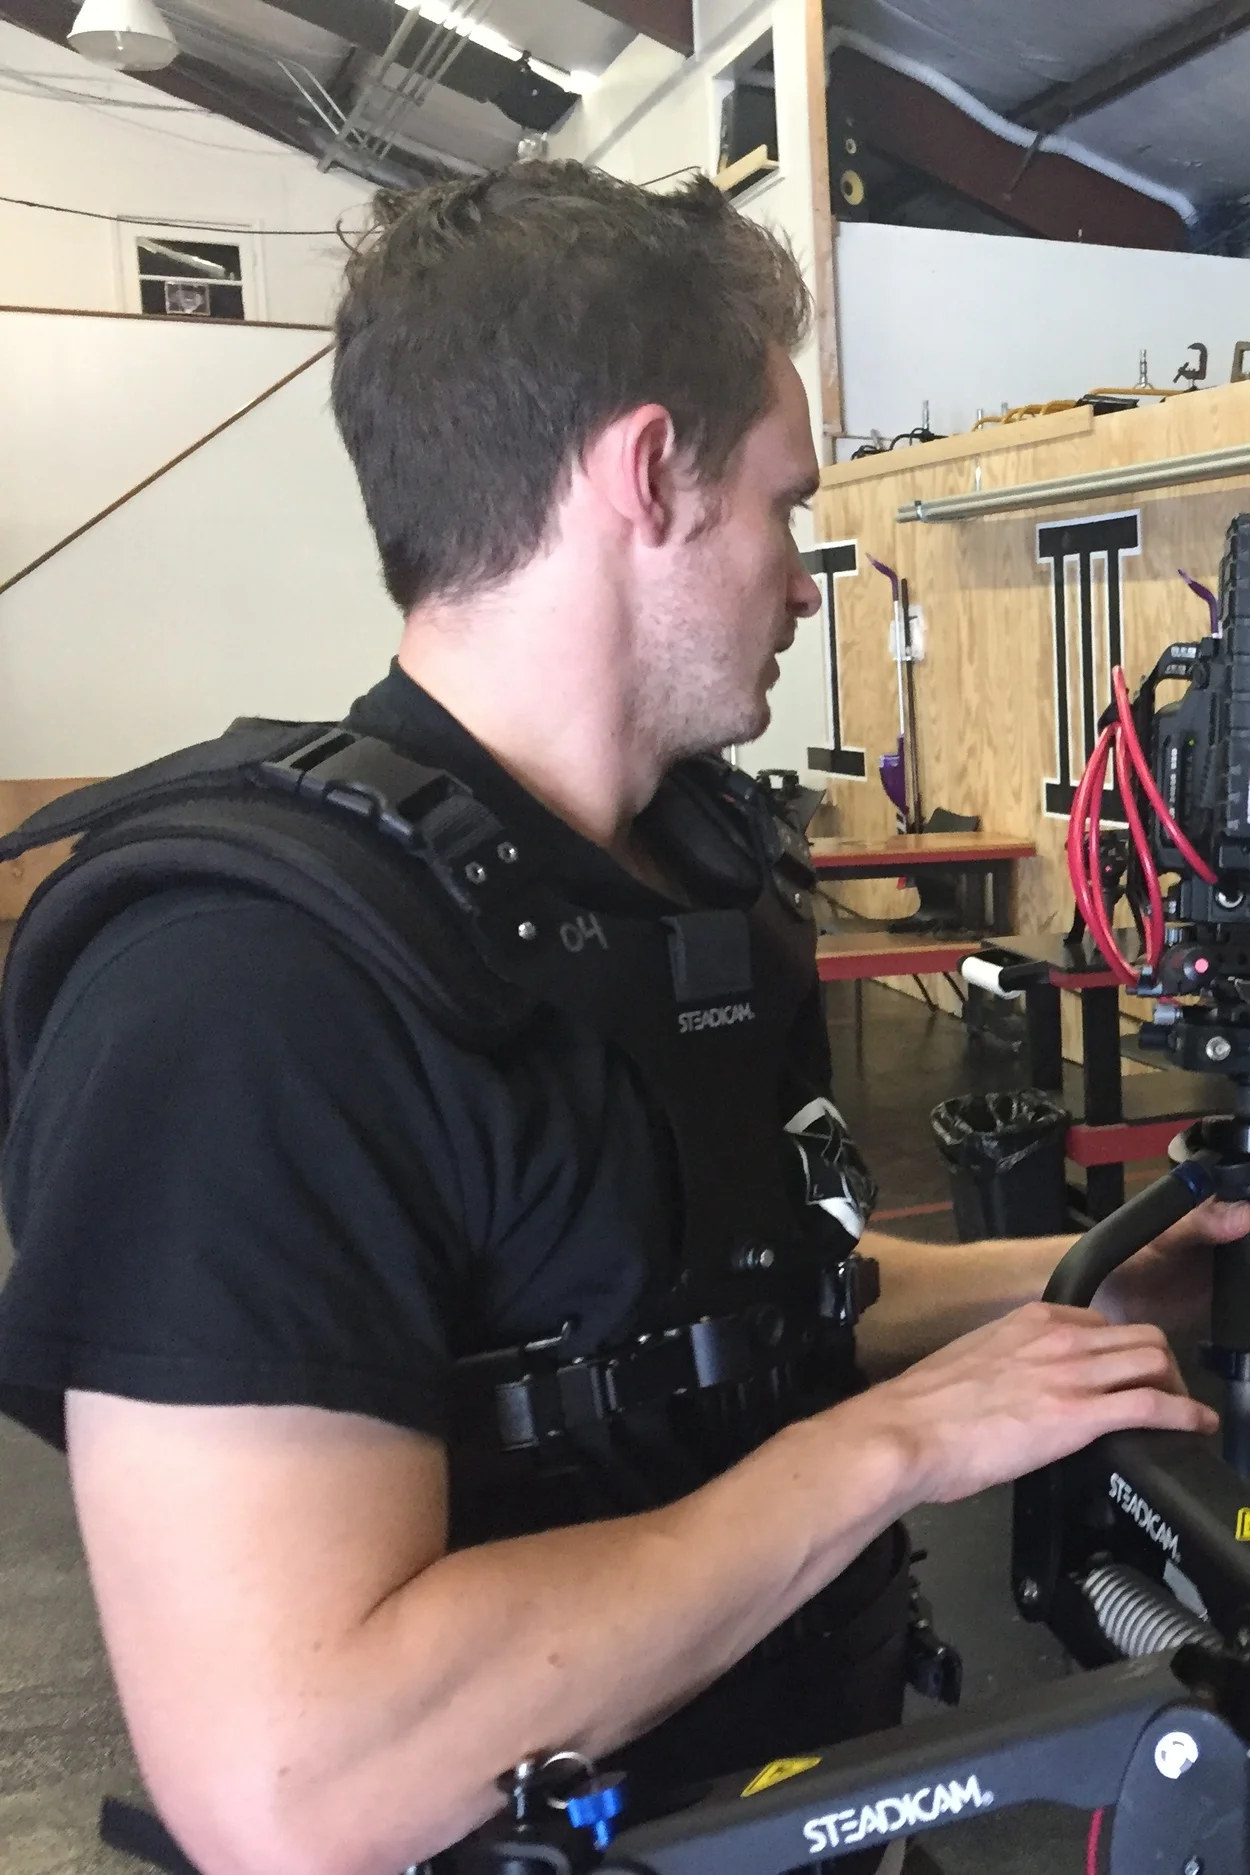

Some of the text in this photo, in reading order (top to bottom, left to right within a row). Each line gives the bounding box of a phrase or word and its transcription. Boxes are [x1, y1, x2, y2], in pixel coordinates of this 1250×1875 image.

[559, 912, 610, 952] 04
[677, 1002, 755, 1034] STEADICAM
[1108, 1472, 1181, 1564] STEADICAM
[802, 1774, 994, 1854] STEADICAM
